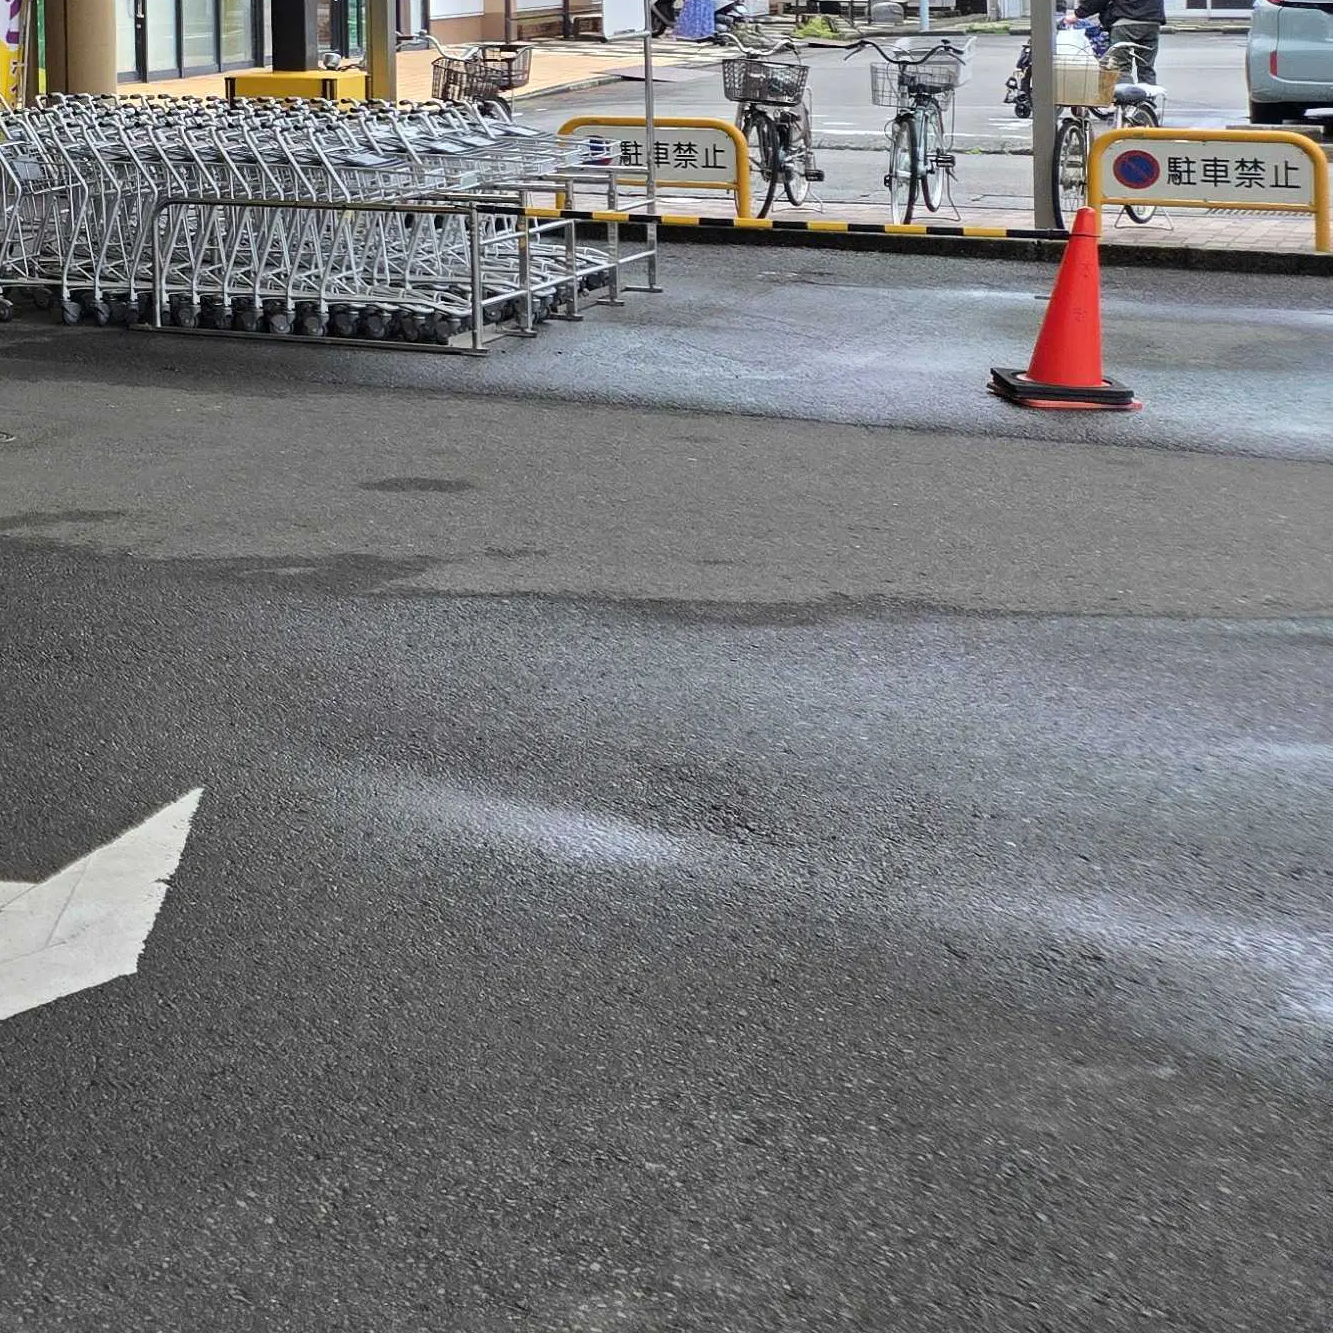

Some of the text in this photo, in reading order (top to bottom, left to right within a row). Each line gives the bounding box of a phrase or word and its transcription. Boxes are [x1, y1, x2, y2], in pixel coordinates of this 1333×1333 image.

[619, 140, 728, 170] 駐車禁止
[1167, 156, 1301, 189] 駐車禁止
